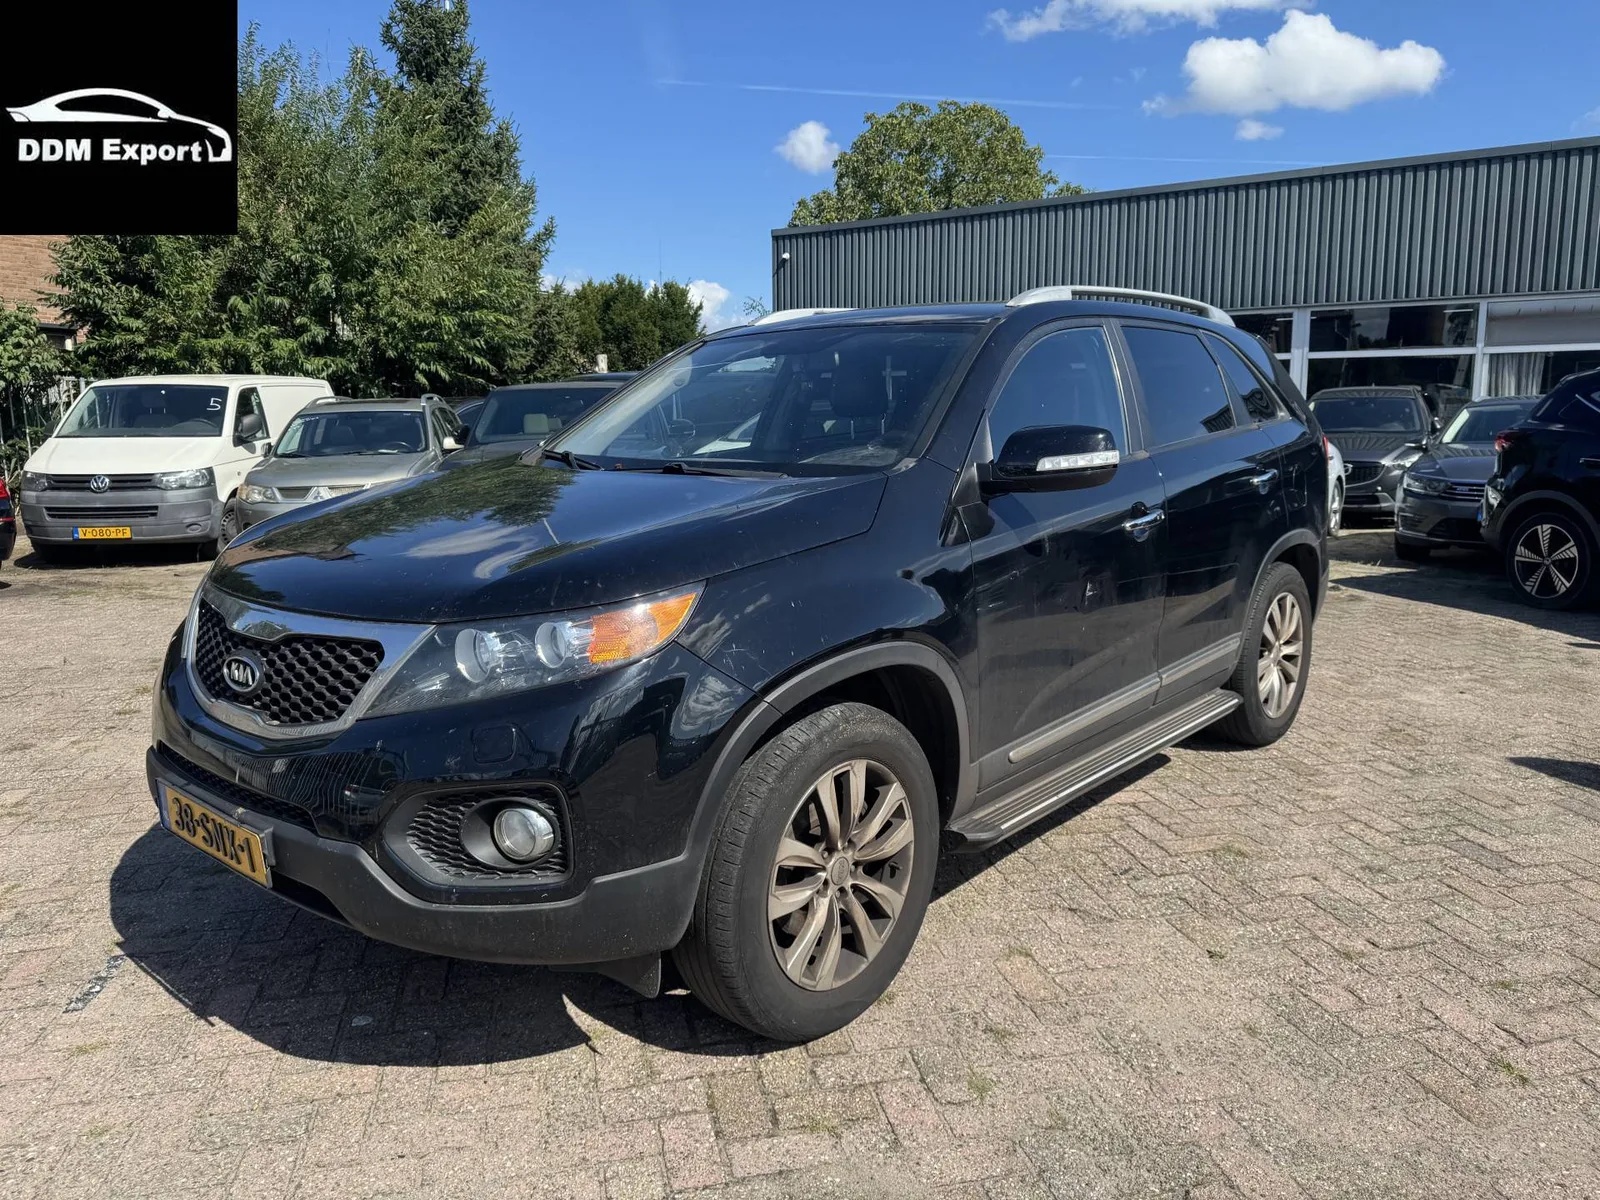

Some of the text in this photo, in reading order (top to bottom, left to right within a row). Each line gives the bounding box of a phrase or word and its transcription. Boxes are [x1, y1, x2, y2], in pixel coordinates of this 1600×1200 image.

[206, 397, 222, 411] 5
[81, 528, 127, 538] V-080-PF
[230, 660, 253, 685] KIA
